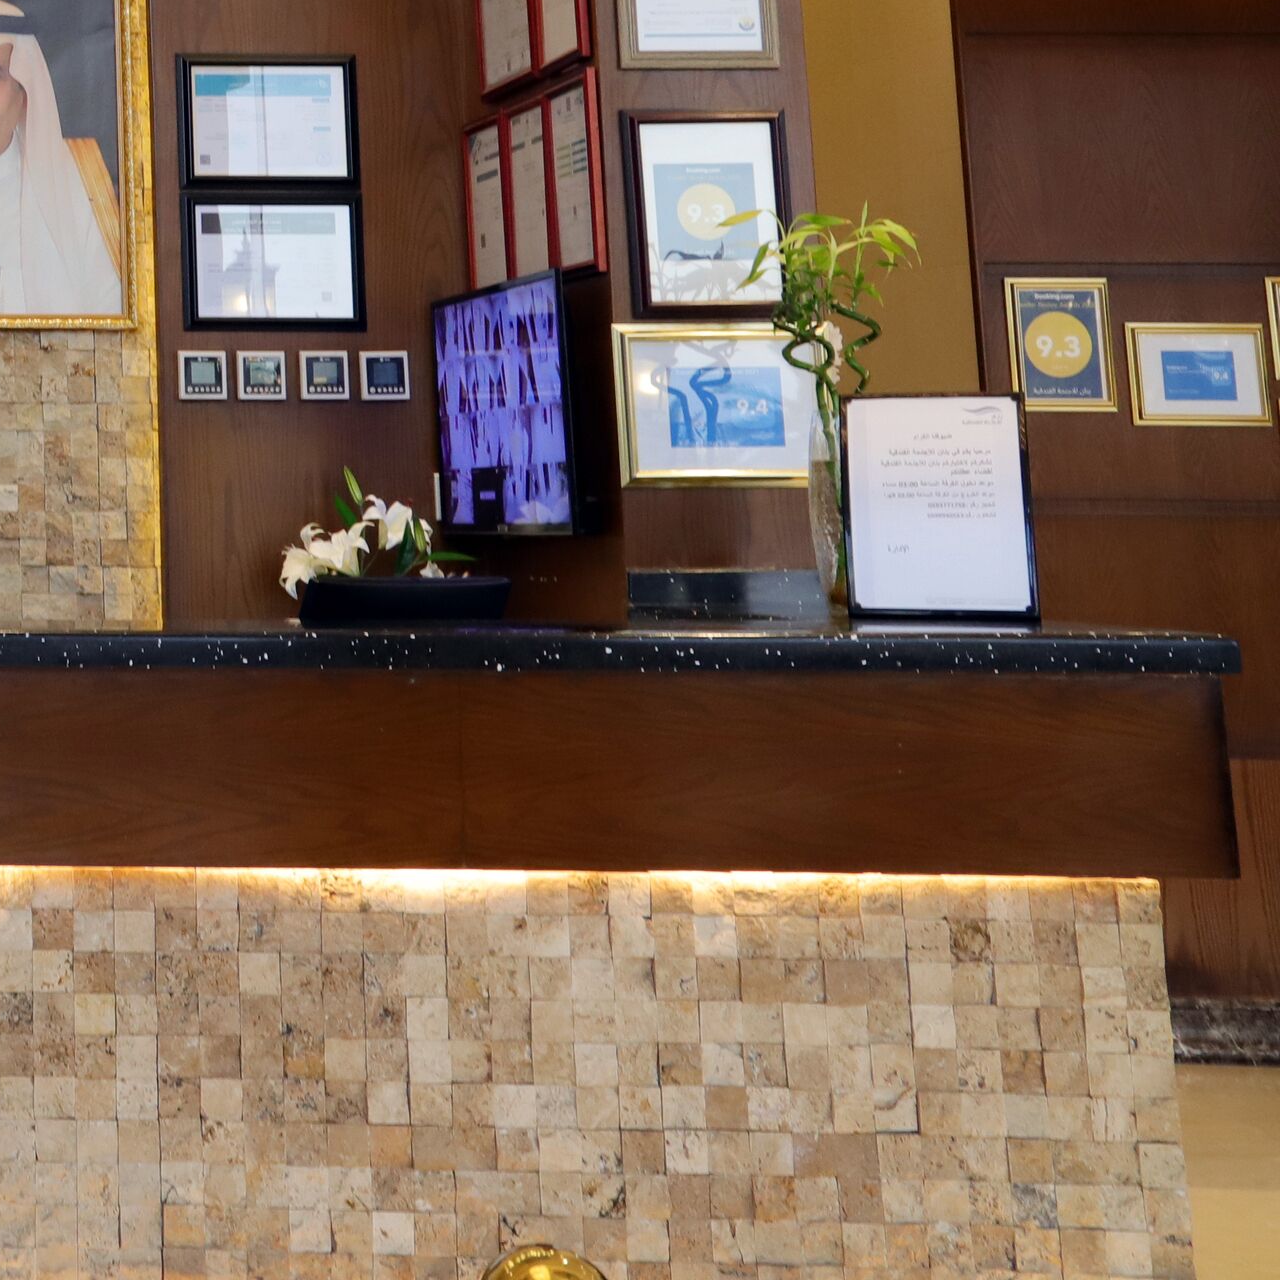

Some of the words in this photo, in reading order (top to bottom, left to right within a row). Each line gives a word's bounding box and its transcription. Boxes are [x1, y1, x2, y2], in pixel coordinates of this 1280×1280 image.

[687, 203, 726, 223] 9.3
[1036, 335, 1082, 358] 9.3
[1213, 371, 1229, 380] 9.4
[736, 399, 769, 416] 9.4
